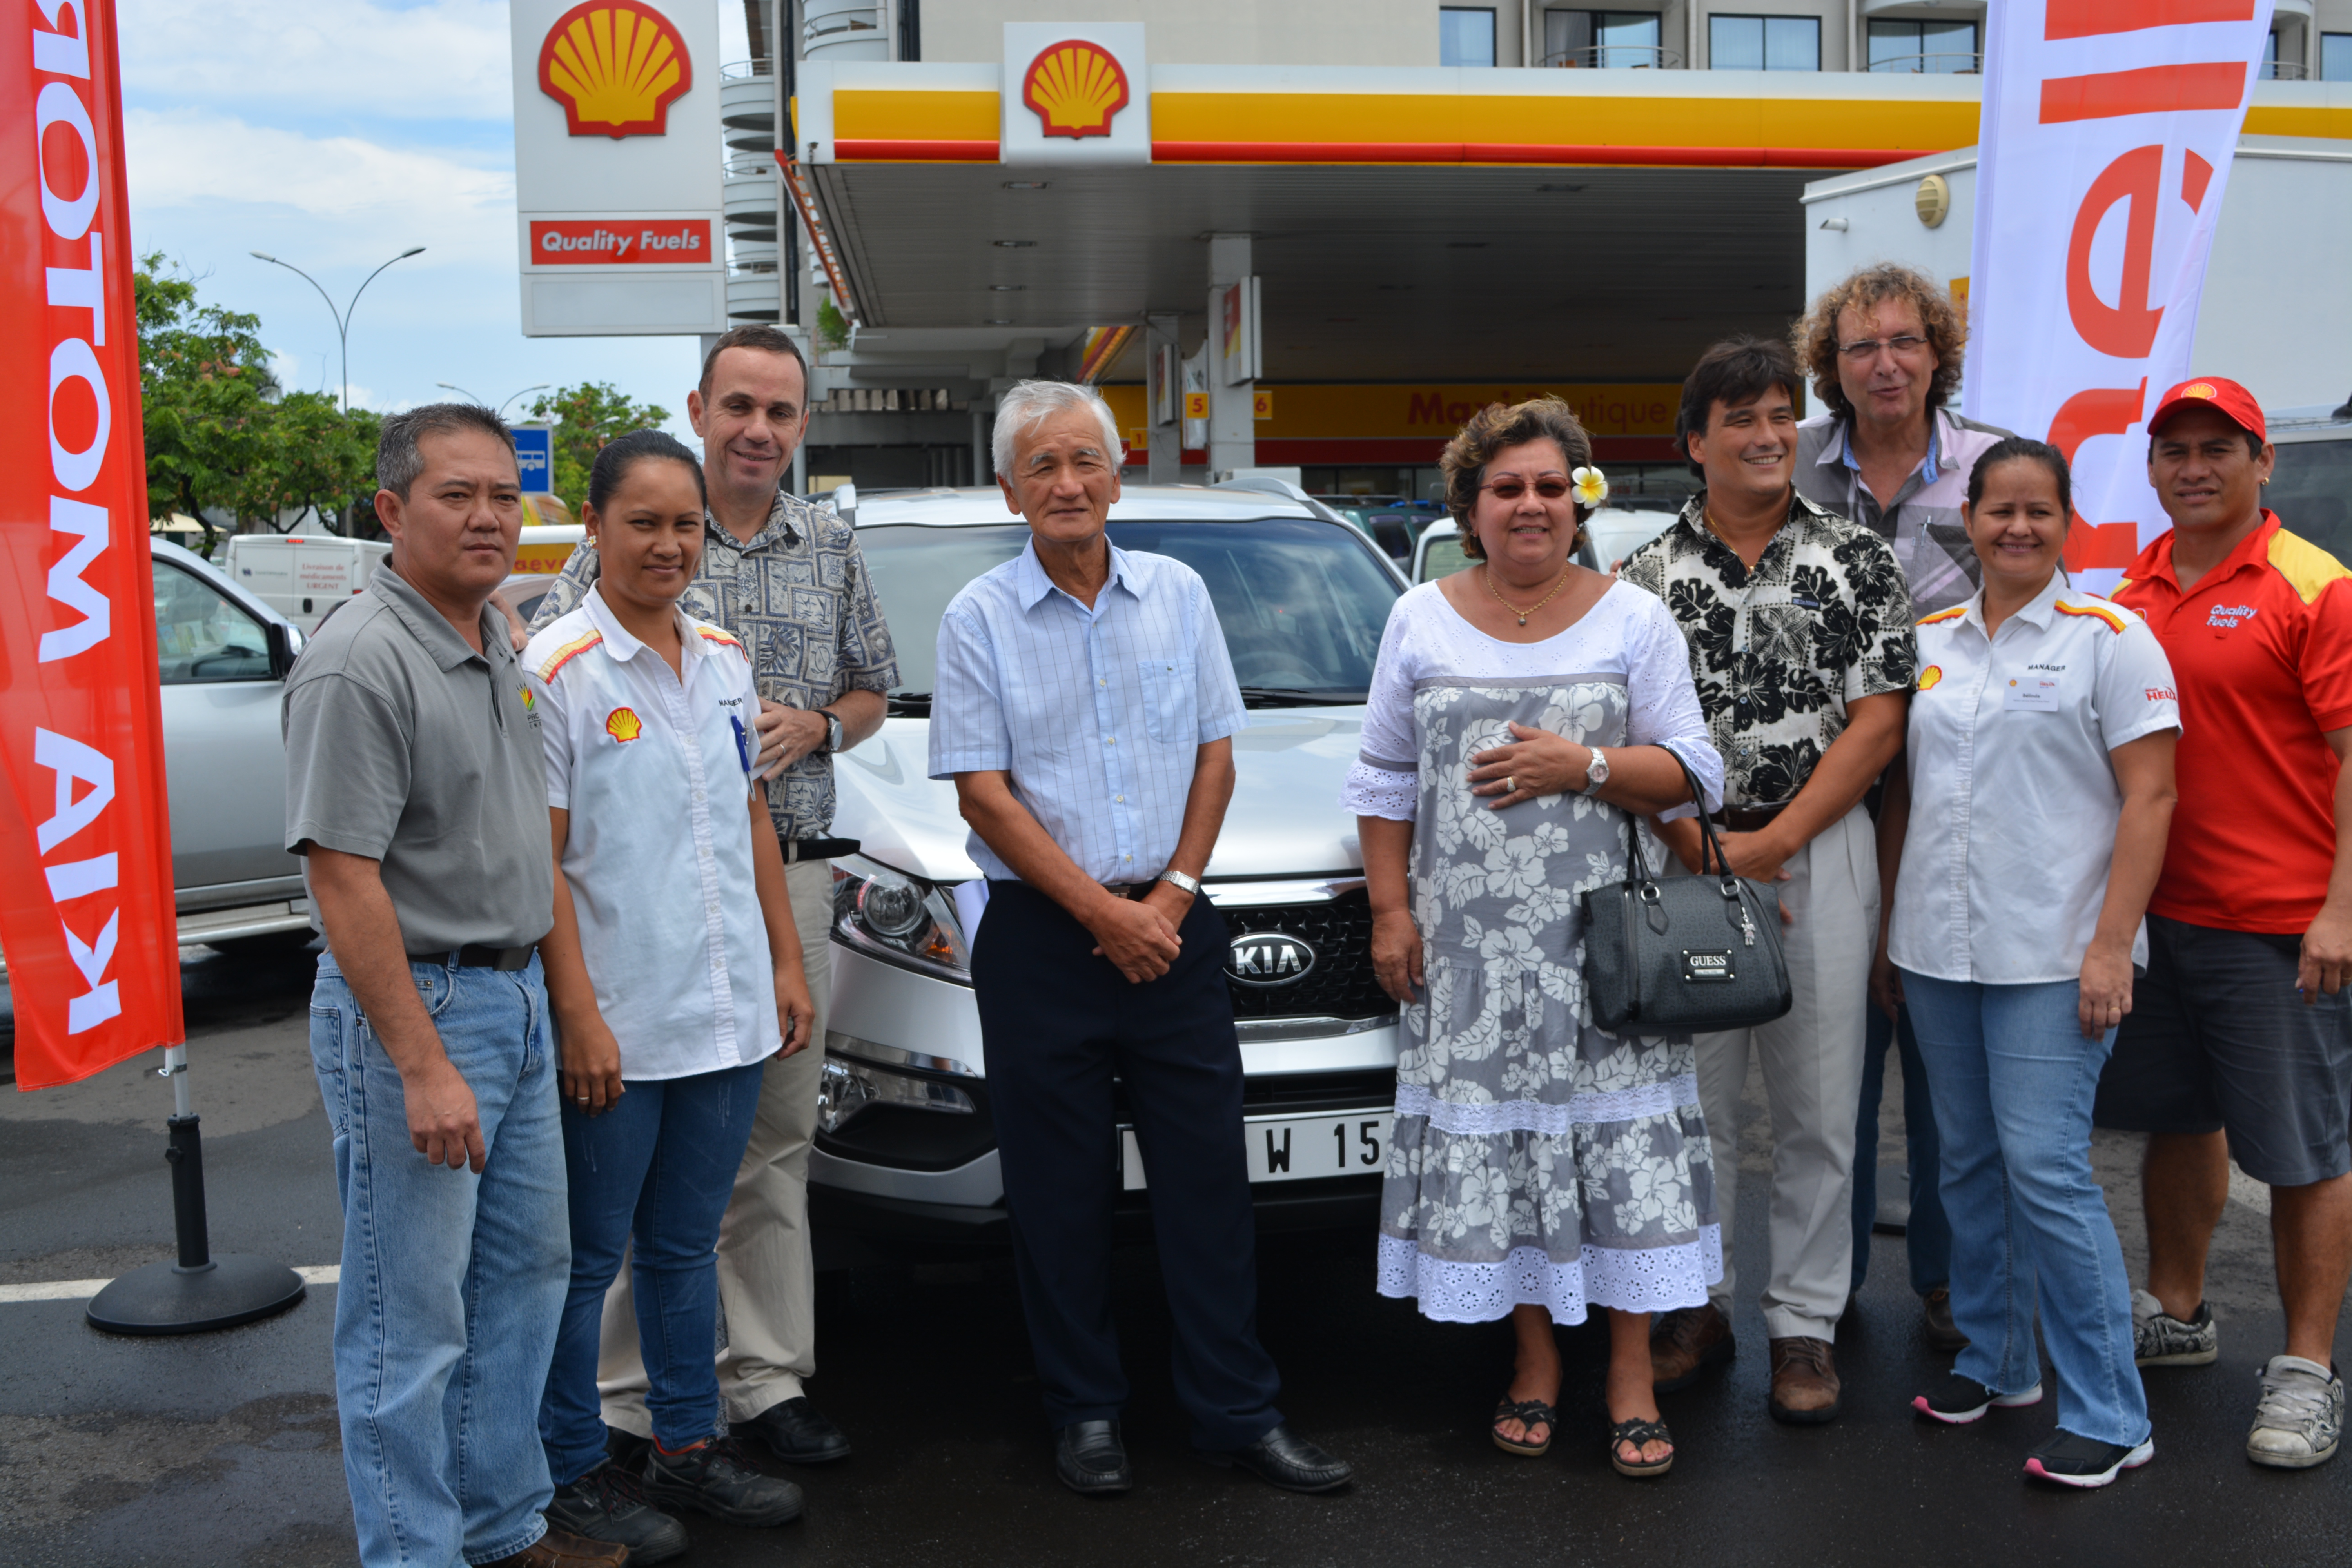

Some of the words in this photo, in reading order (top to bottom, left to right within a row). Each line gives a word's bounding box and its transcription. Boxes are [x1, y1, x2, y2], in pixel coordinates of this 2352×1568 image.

[541, 229, 633, 256] Quality
[640, 229, 700, 250] Fuels
[2039, 0, 2254, 600] hell
[1192, 398, 1203, 412] 5
[1255, 397, 1267, 412] 6
[1526, 392, 1667, 434] utique
[1136, 433, 1142, 445] 1
[2210, 604, 2258, 620] Quality
[2206, 615, 2239, 628] Fuels
[1234, 945, 1302, 975] KIA
[1690, 955, 1727, 966] GUESS
[1266, 1128, 1291, 1173] W
[1334, 1120, 1379, 1168] 15
